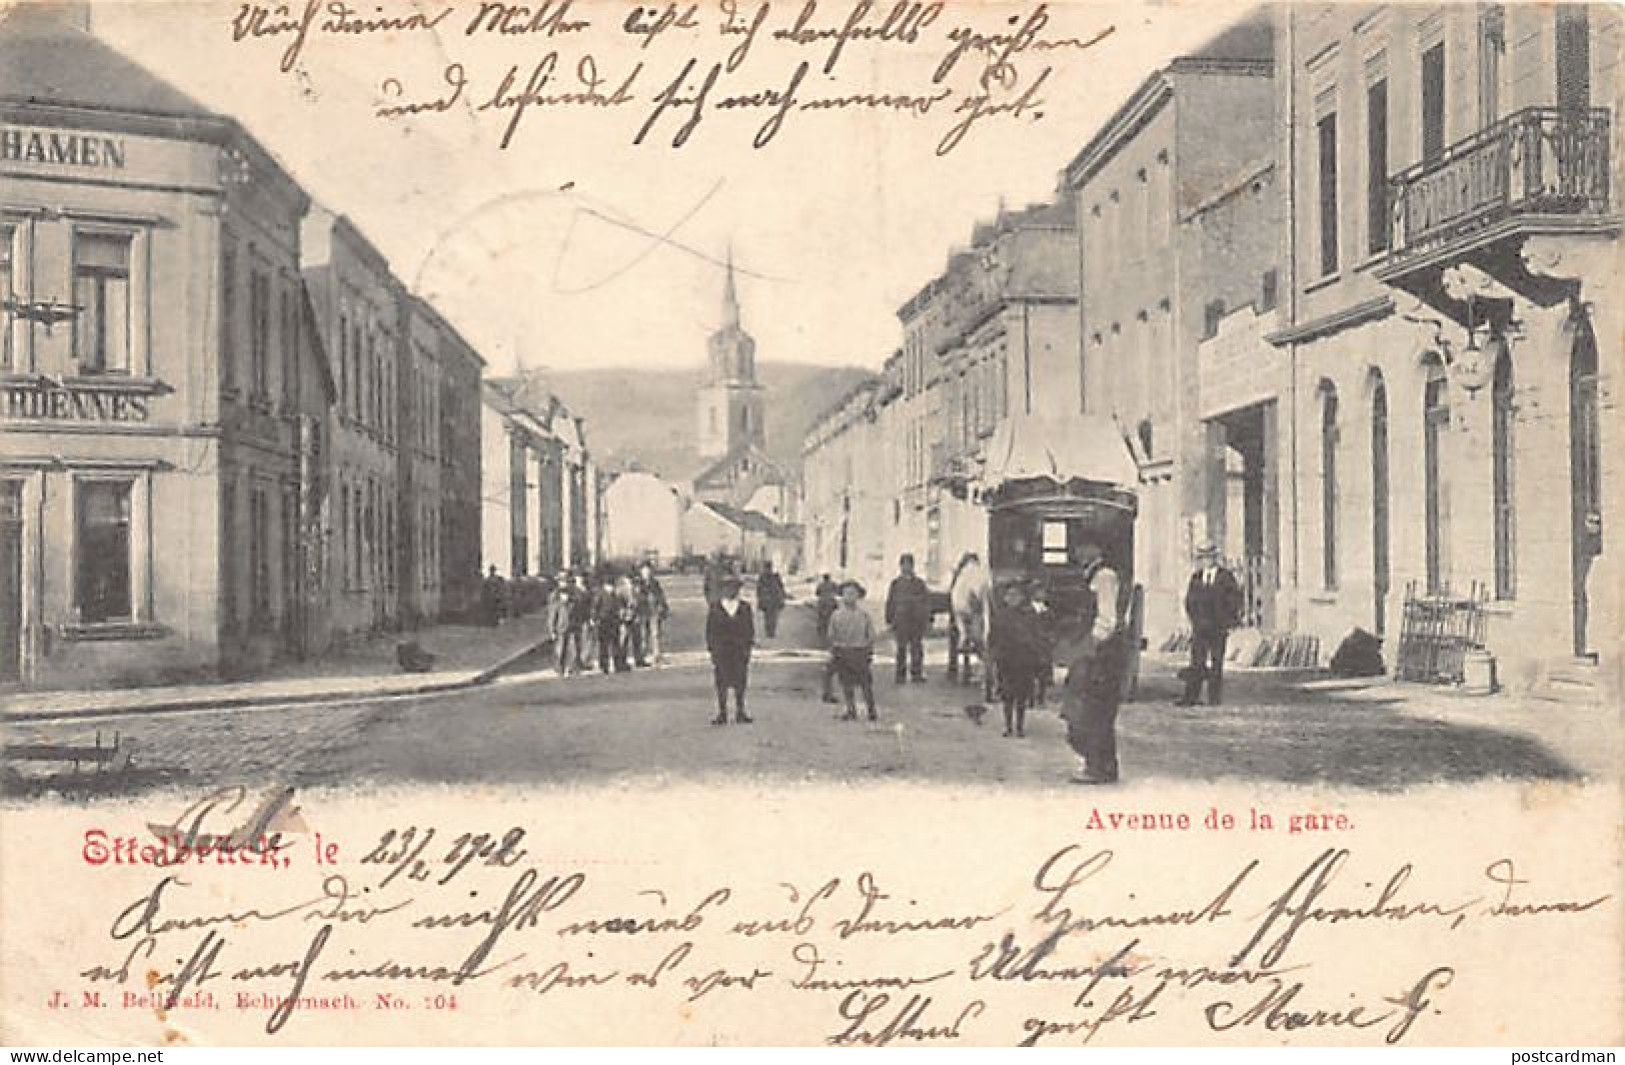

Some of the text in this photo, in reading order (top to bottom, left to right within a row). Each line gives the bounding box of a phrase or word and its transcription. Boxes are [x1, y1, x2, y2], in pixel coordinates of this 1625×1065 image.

[376, 63, 467, 117] und
[478, 51, 634, 149] befindet
[633, 57, 722, 148] sich
[715, 62, 808, 149] noch
[1085, 808, 1356, 833] Avenue de la gare.
[315, 832, 339, 865] le
[728, 878, 840, 935] aus
[626, 942, 692, 986] es
[83, 993, 107, 1008] M.
[375, 992, 410, 1009] No.
[1205, 978, 1394, 1031] Marie
